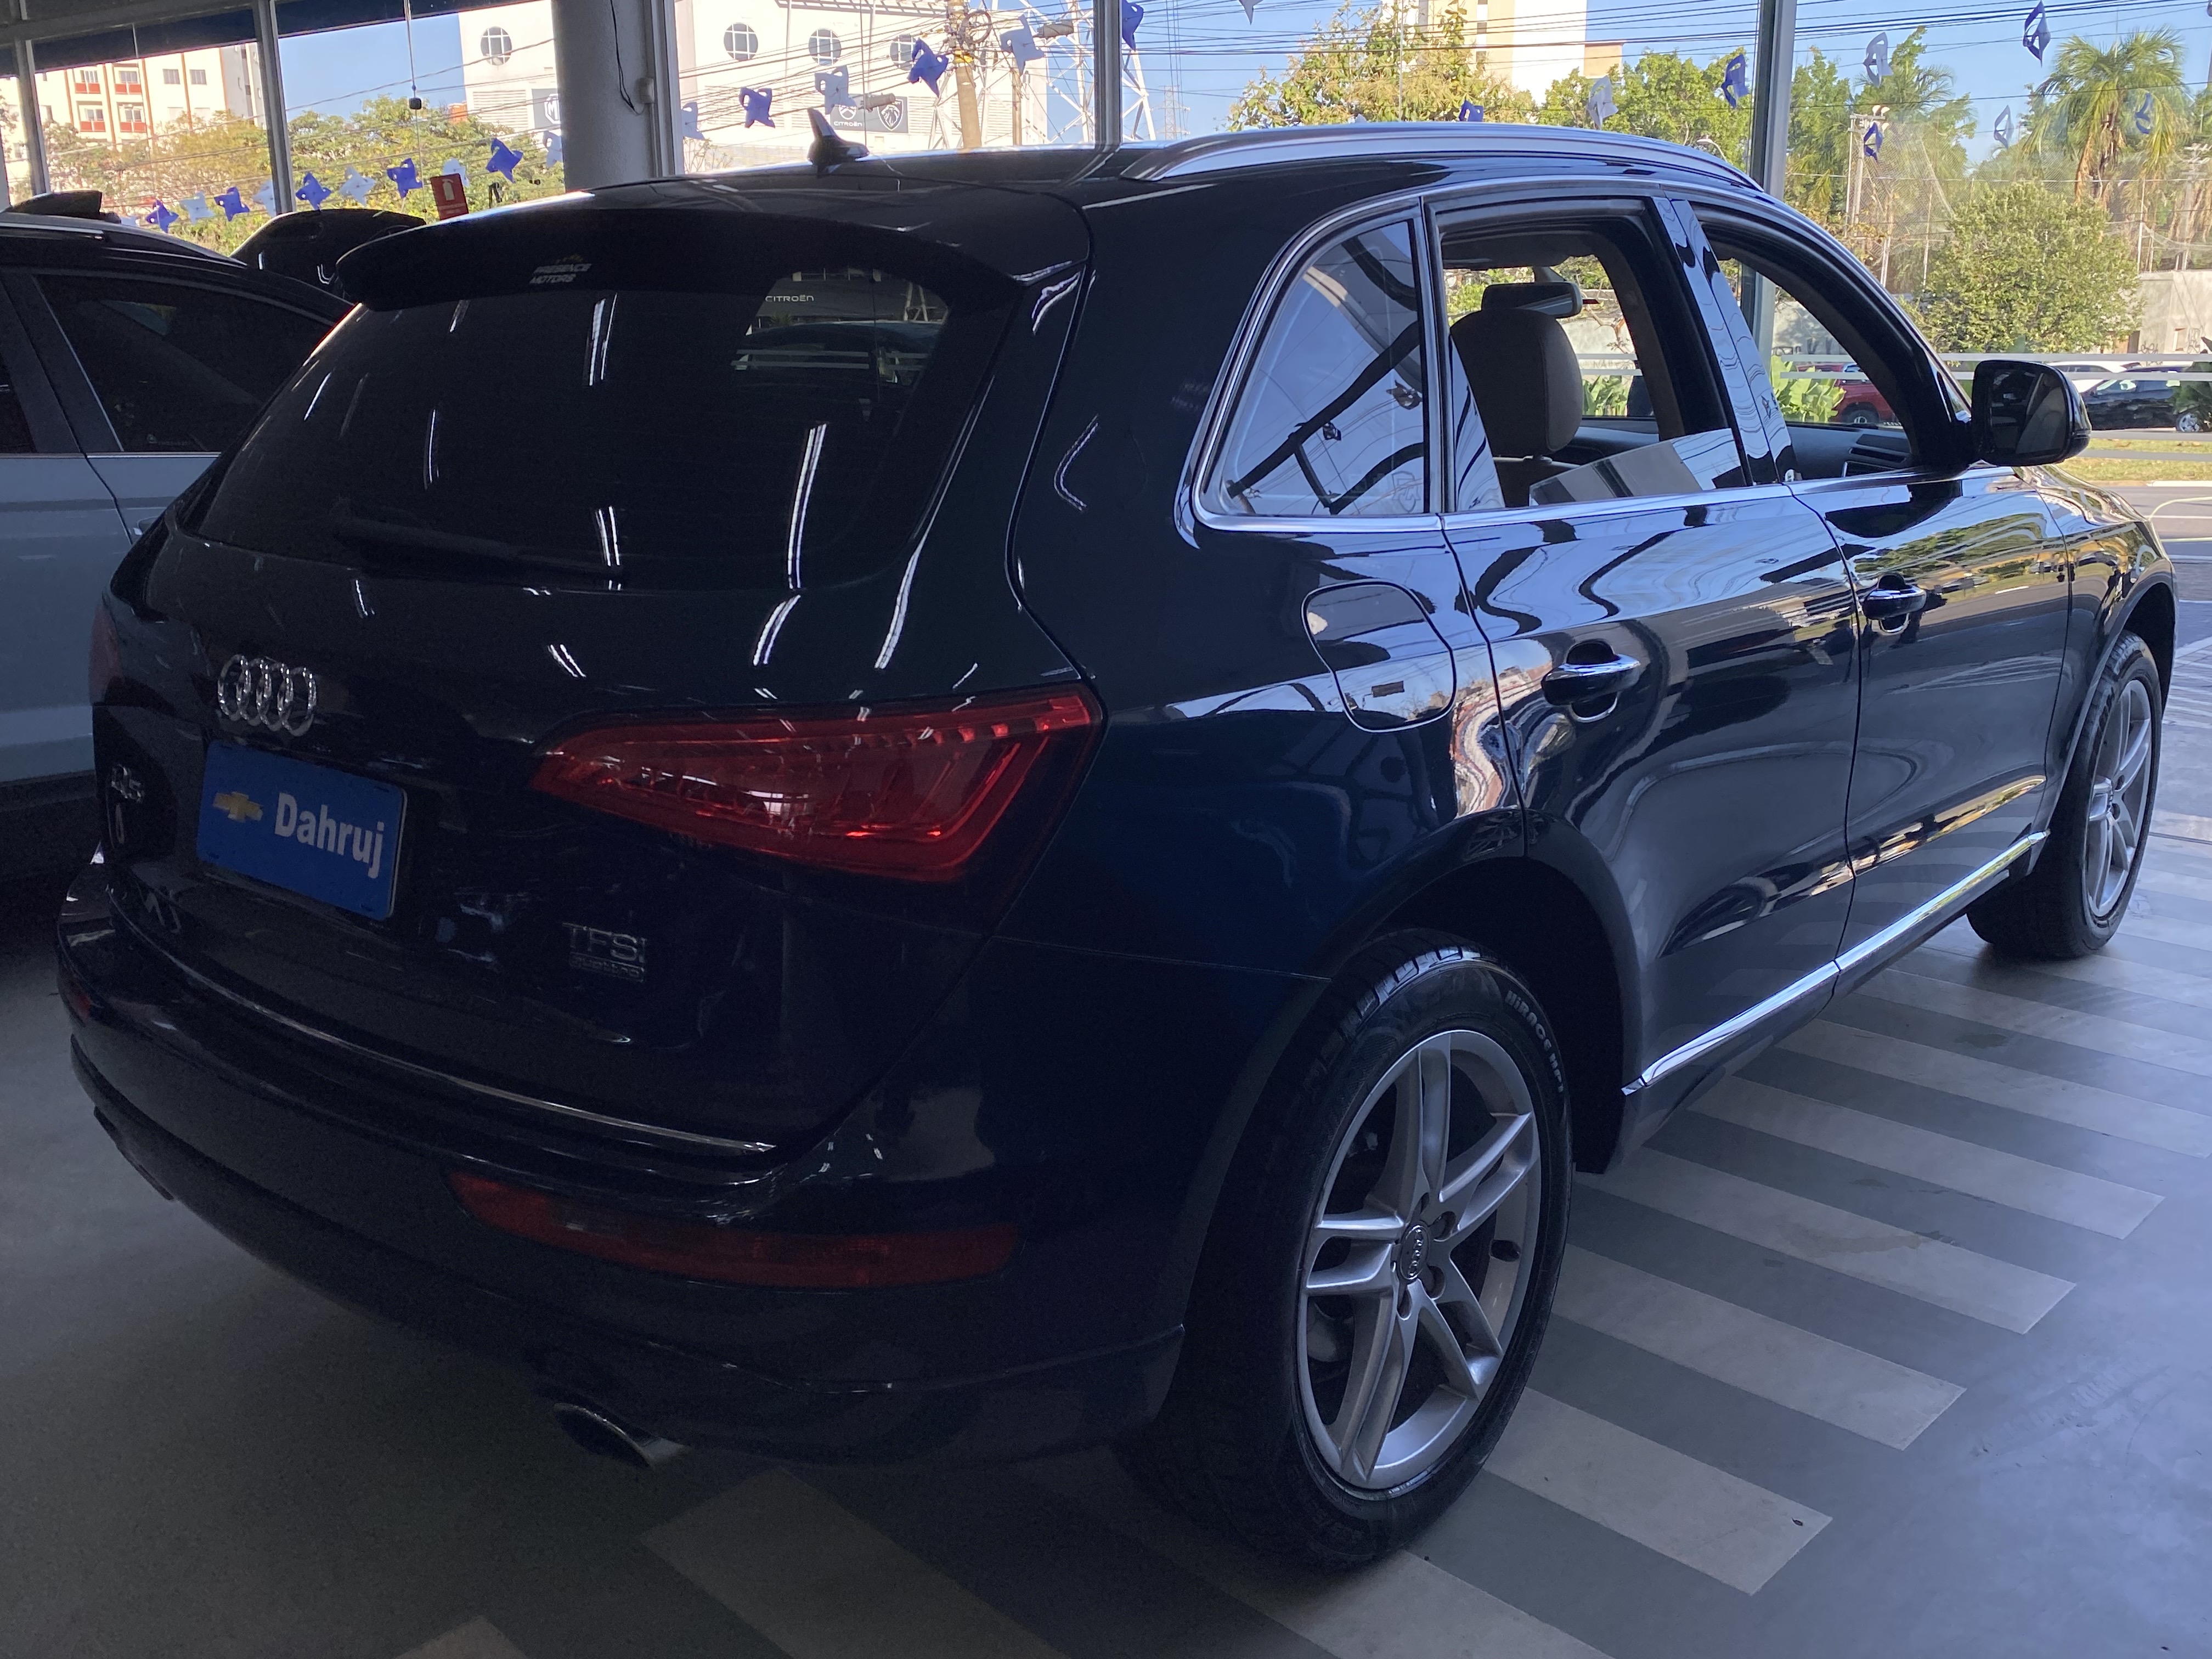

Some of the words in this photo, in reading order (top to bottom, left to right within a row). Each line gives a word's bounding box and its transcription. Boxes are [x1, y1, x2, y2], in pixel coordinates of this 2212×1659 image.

[111, 764, 145, 803] Q5
[274, 792, 385, 879] Dahruj
[562, 922, 647, 963] TFSI
